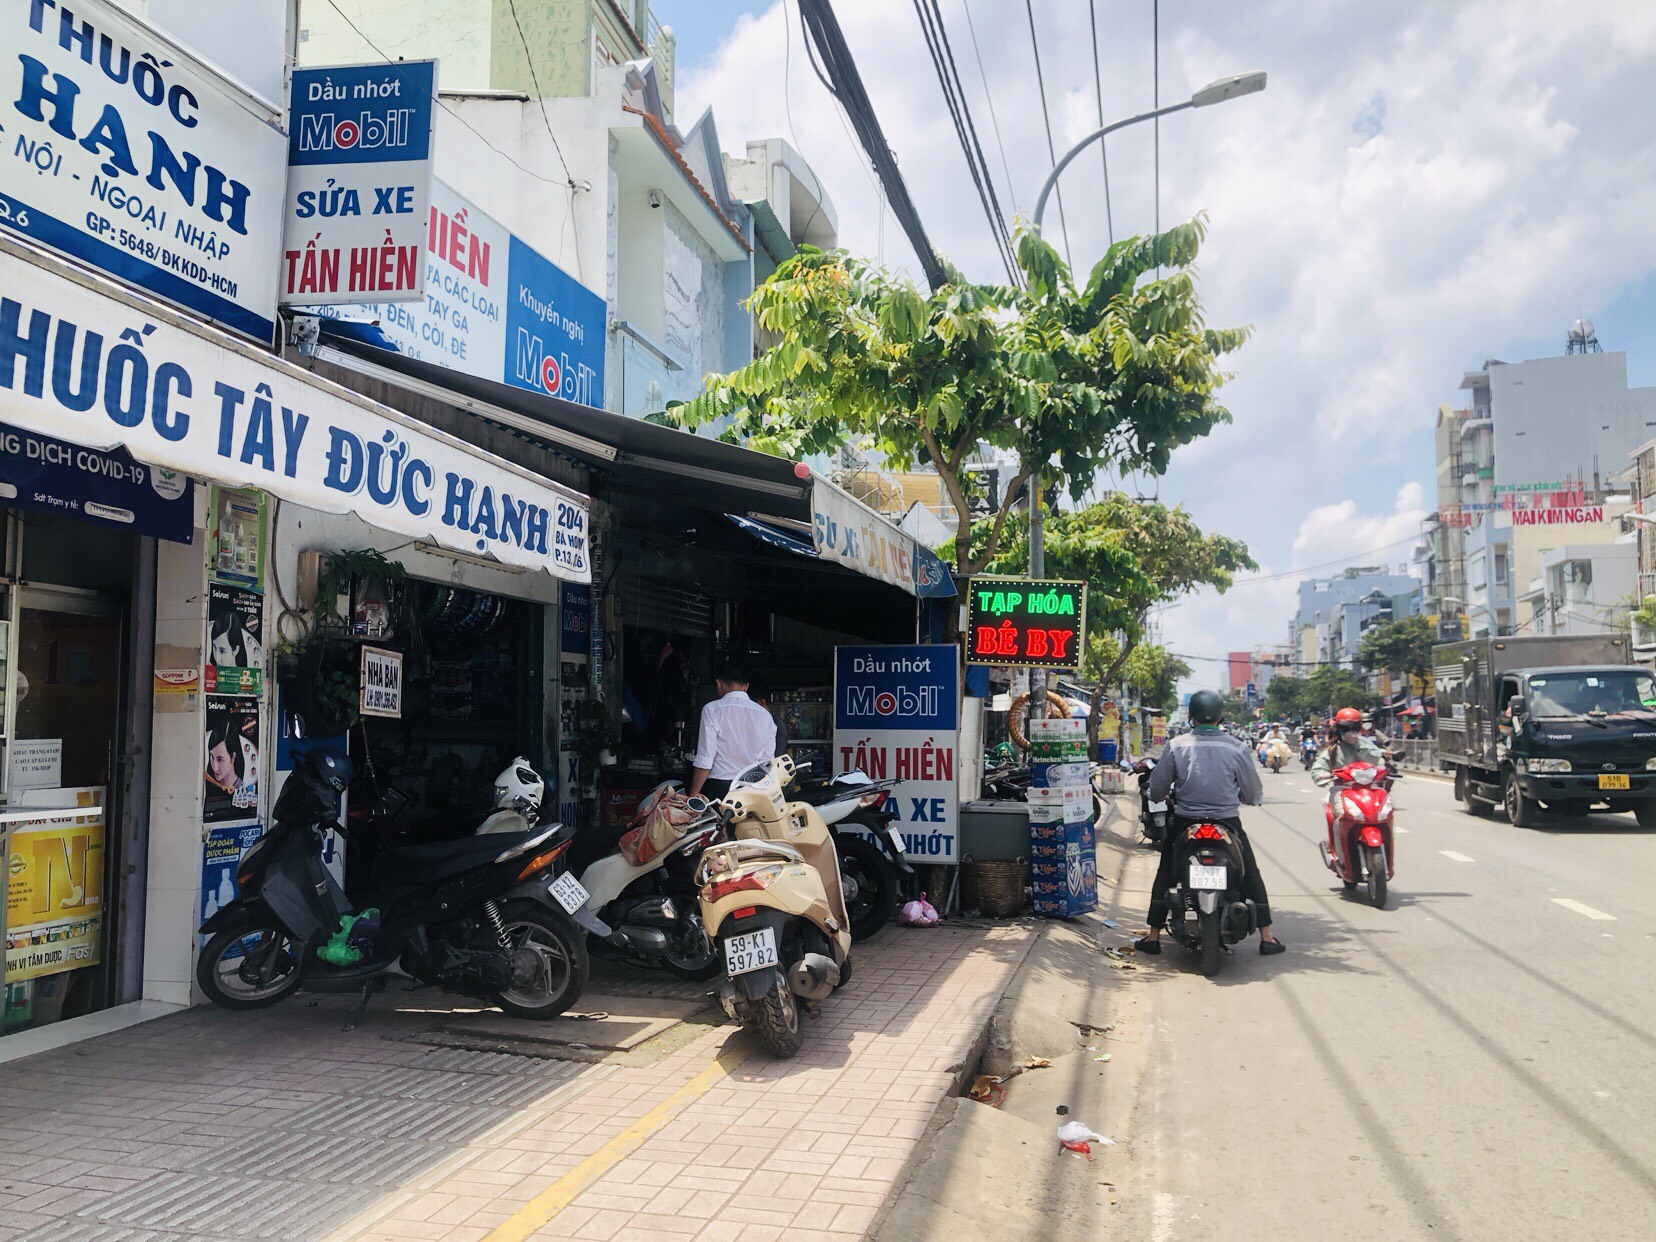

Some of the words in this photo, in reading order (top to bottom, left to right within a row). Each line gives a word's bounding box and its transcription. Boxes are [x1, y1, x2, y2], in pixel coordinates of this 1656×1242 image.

[29, 0, 199, 128] THUỐC
[309, 77, 346, 101] Dầu
[354, 79, 401, 100] nhớt
[14, 54, 251, 236] HẠNH
[300, 110, 409, 150] Mobil
[14, 134, 62, 177] NỘI
[91, 175, 166, 231] NGOẠI
[175, 219, 230, 261] NHẬP
[296, 178, 361, 218] SỬA
[374, 186, 415, 215] XE
[286, 233, 340, 294] TẤN
[349, 229, 418, 293] HIỀN
[427, 294, 449, 321] TAY
[452, 310, 468, 334] GA
[444, 276, 468, 303] CÁC
[472, 292, 498, 322] LOẠI
[519, 284, 559, 326] Khuyến
[562, 317, 584, 346] nghị
[516, 326, 592, 406] Mobil
[0, 297, 193, 442] HUỐC
[214, 382, 310, 479] TÂY
[326, 426, 433, 518] ĐỨC
[441, 470, 549, 555] HẠNH
[26, 438, 71, 466] DỊCH
[77, 452, 144, 485] COVID-19
[47, 495, 64, 507] Trạm
[558, 503, 583, 532] 204
[1513, 510, 1535, 525] MAI
[1538, 508, 1562, 524] KIM
[556, 530, 567, 546] BÀ
[978, 591, 1022, 616] TẠP
[1028, 589, 1074, 615] HÓA
[976, 620, 1018, 655] BÉ
[1026, 629, 1073, 657] BY
[368, 657, 383, 687] NHÀ
[385, 660, 398, 689] BÁN
[853, 654, 885, 673] Dầu
[891, 657, 931, 673] nhớt
[847, 686, 938, 716] Mobil
[841, 737, 886, 780] TẤN
[896, 737, 953, 781] HIỀN
[911, 798, 945, 822] XE
[563, 887, 585, 909] 8378
[28, 954, 42, 967] TÂM
[728, 948, 774, 972] 597.82
[731, 938, 766, 954] 59-K1
